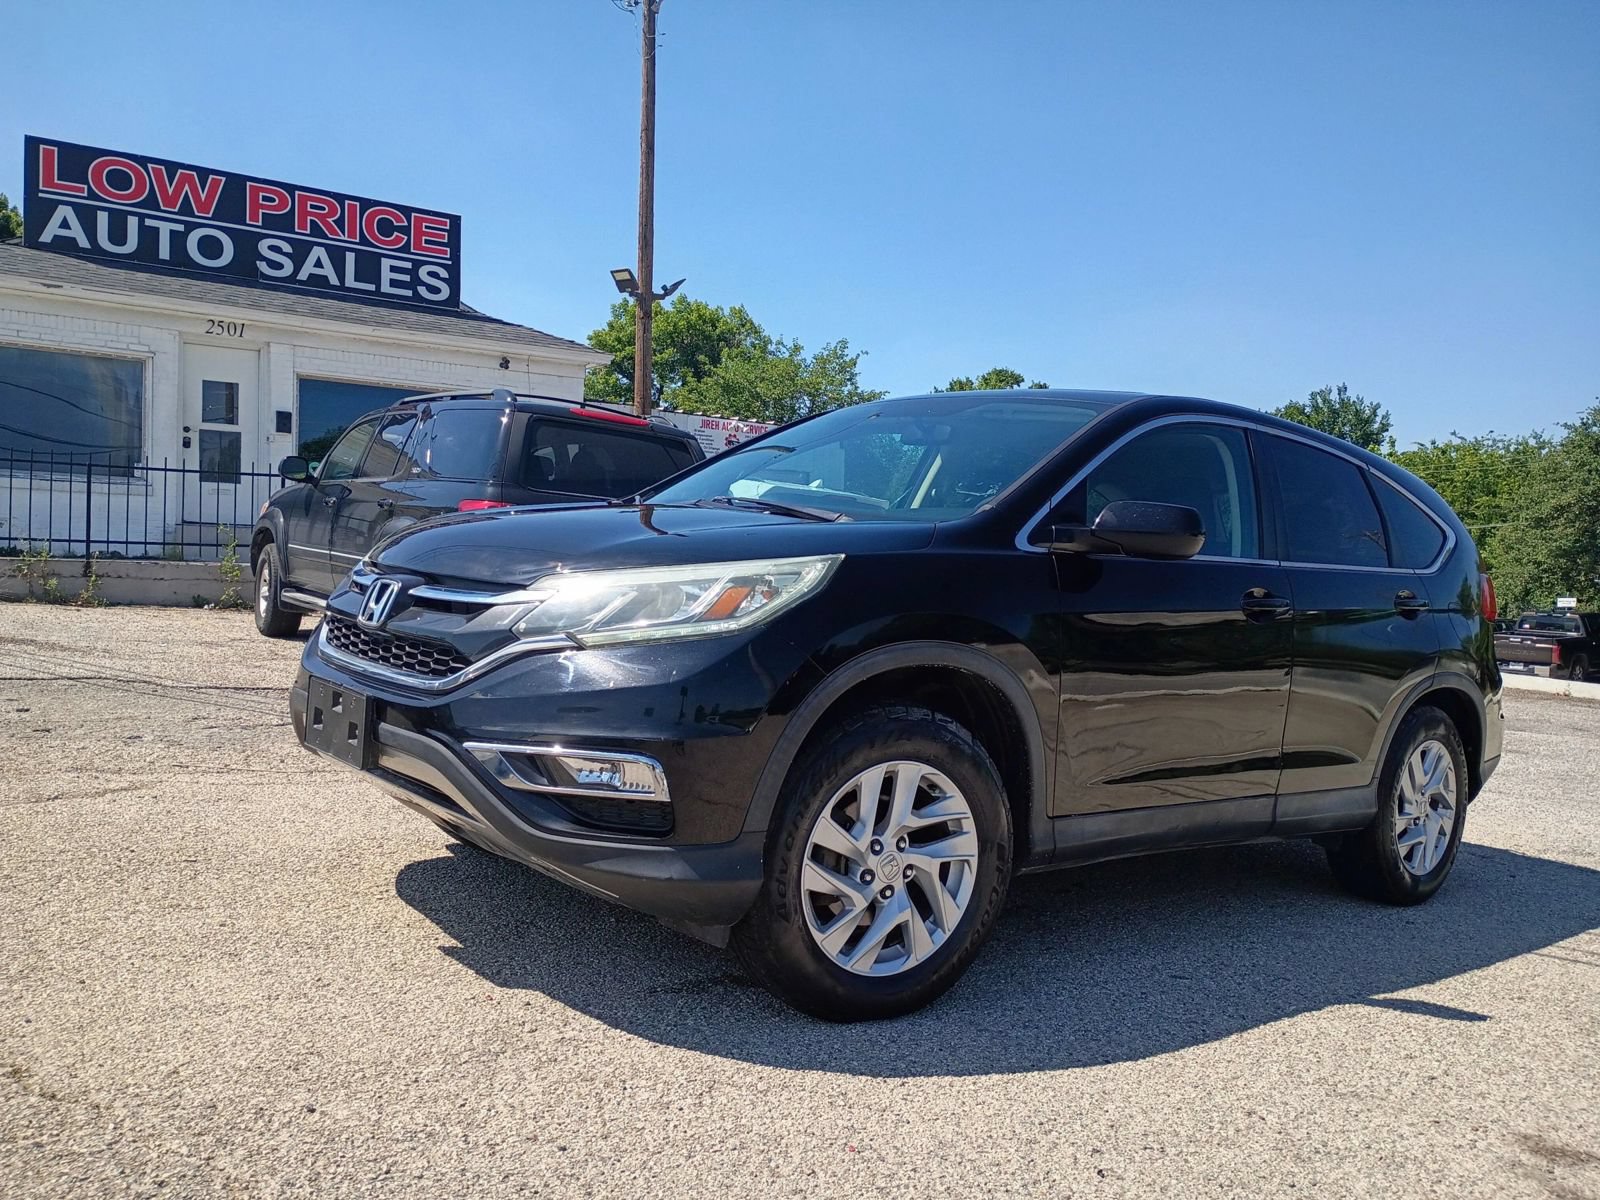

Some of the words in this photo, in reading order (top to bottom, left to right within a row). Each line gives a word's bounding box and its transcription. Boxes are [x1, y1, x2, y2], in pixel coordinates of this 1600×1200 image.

[39, 144, 226, 218] LOW
[246, 181, 450, 258] PRICE
[38, 204, 234, 268] AUTO
[256, 238, 450, 301] SALES
[205, 319, 245, 338] 2501
[700, 419, 720, 430] JIREH
[721, 421, 740, 433] AUO
